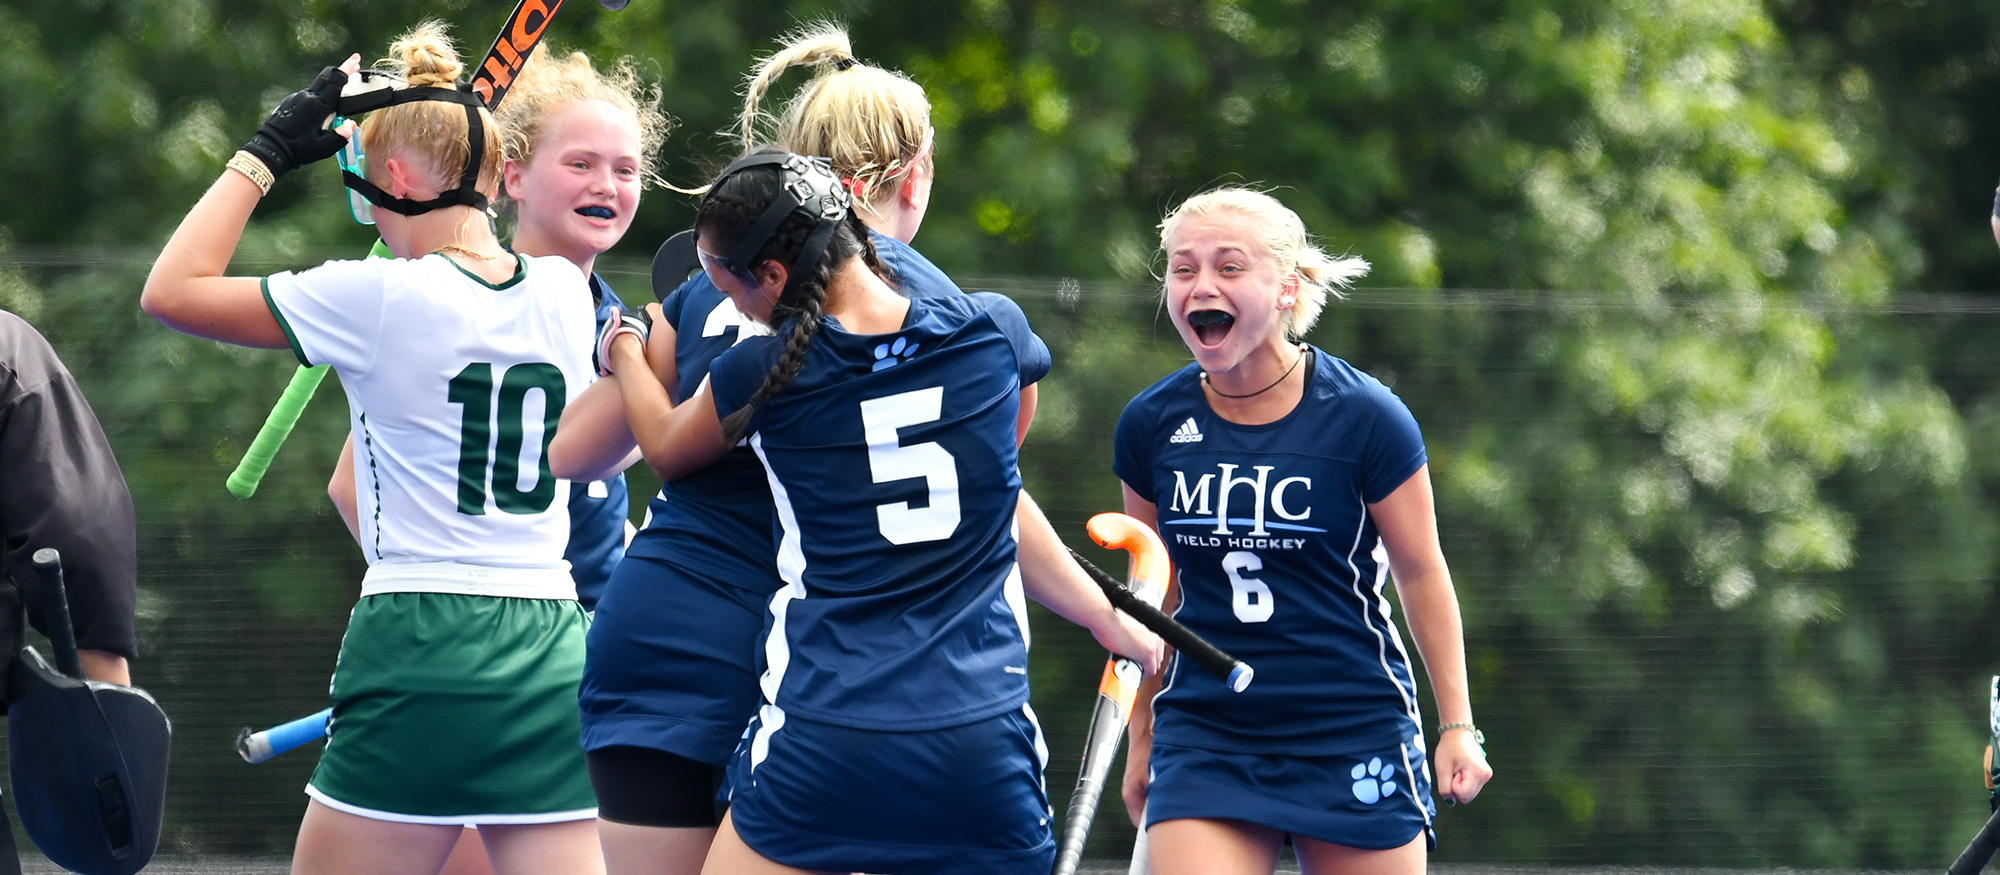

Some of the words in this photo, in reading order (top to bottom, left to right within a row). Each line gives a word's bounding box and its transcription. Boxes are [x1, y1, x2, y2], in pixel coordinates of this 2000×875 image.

[448, 362, 566, 515] 10
[860, 386, 961, 546] 5
[1169, 432, 1204, 443] adidas
[1169, 463, 1312, 537] MHC
[1175, 533, 1221, 547] FIELD
[1228, 537, 1306, 549] HOCKEY
[1221, 551, 1275, 624] 6
